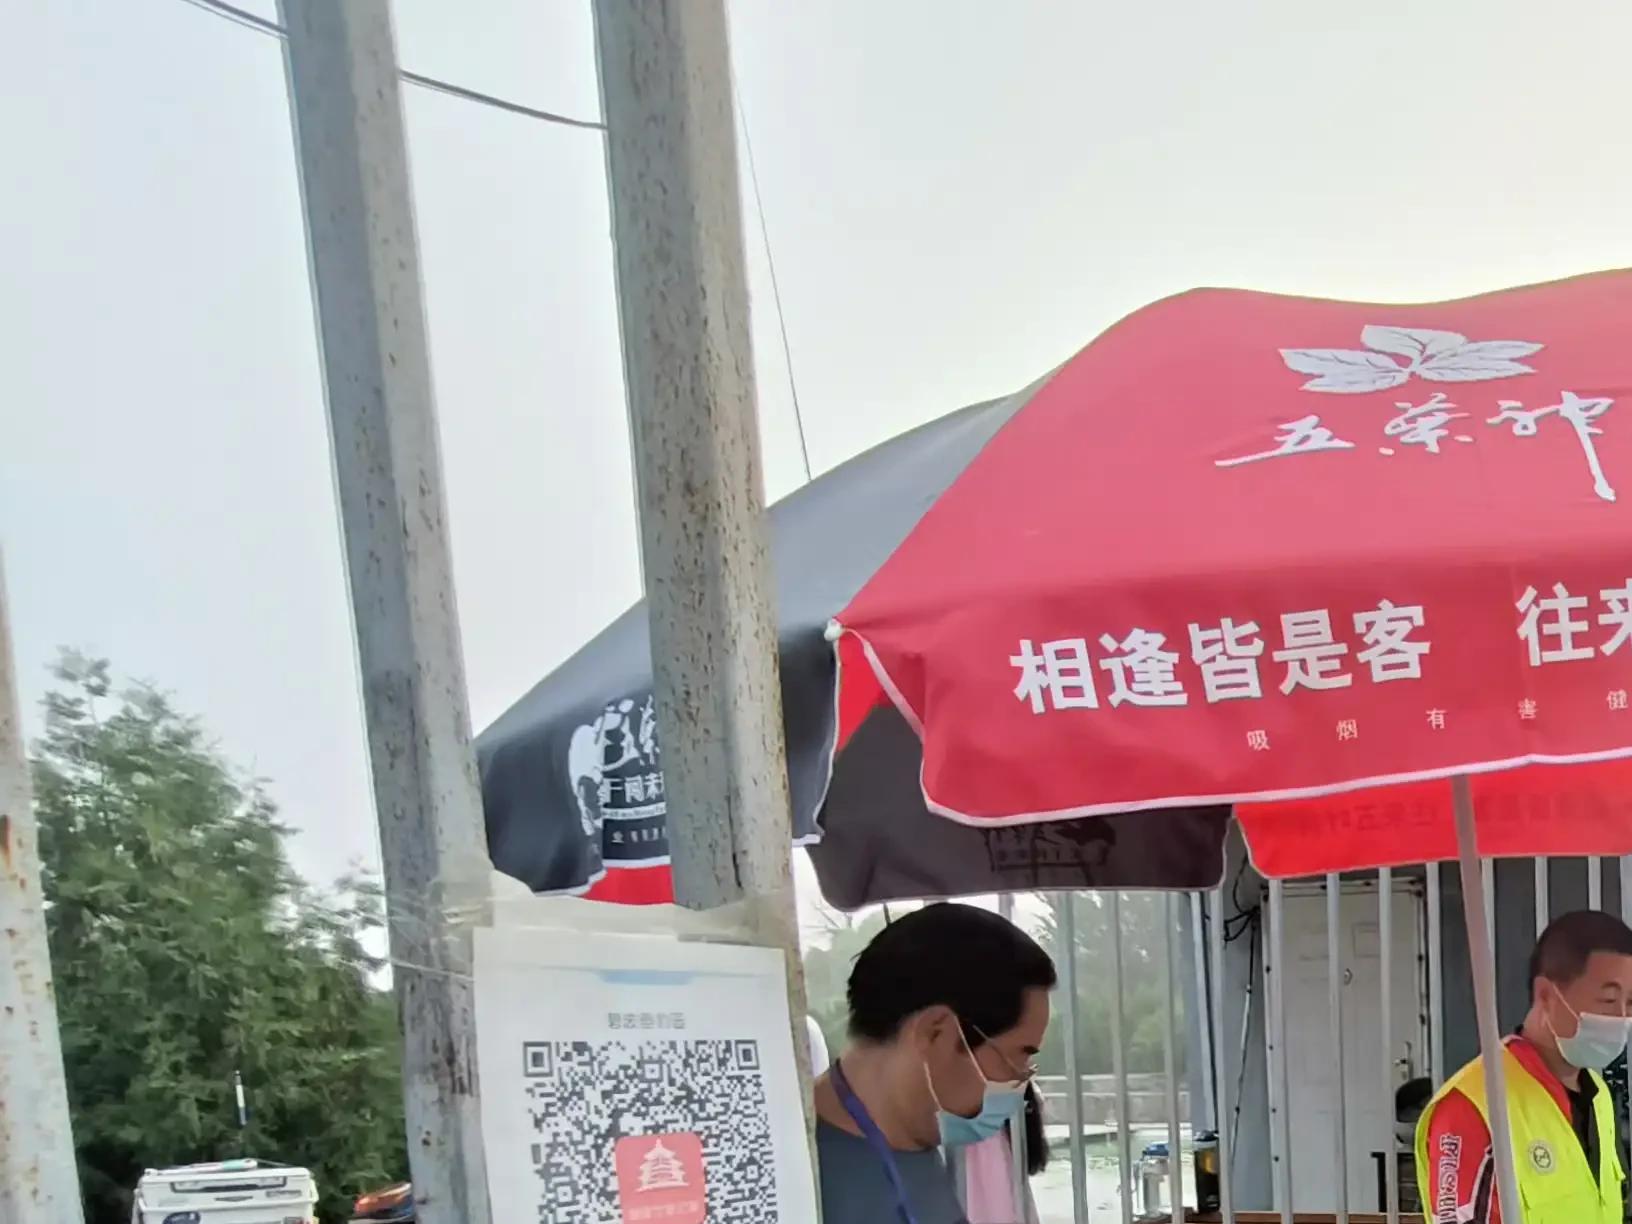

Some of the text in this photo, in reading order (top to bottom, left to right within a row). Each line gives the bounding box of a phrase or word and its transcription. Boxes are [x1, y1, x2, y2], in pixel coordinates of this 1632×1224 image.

[1010, 600, 1431, 714] 相逢皆是客
